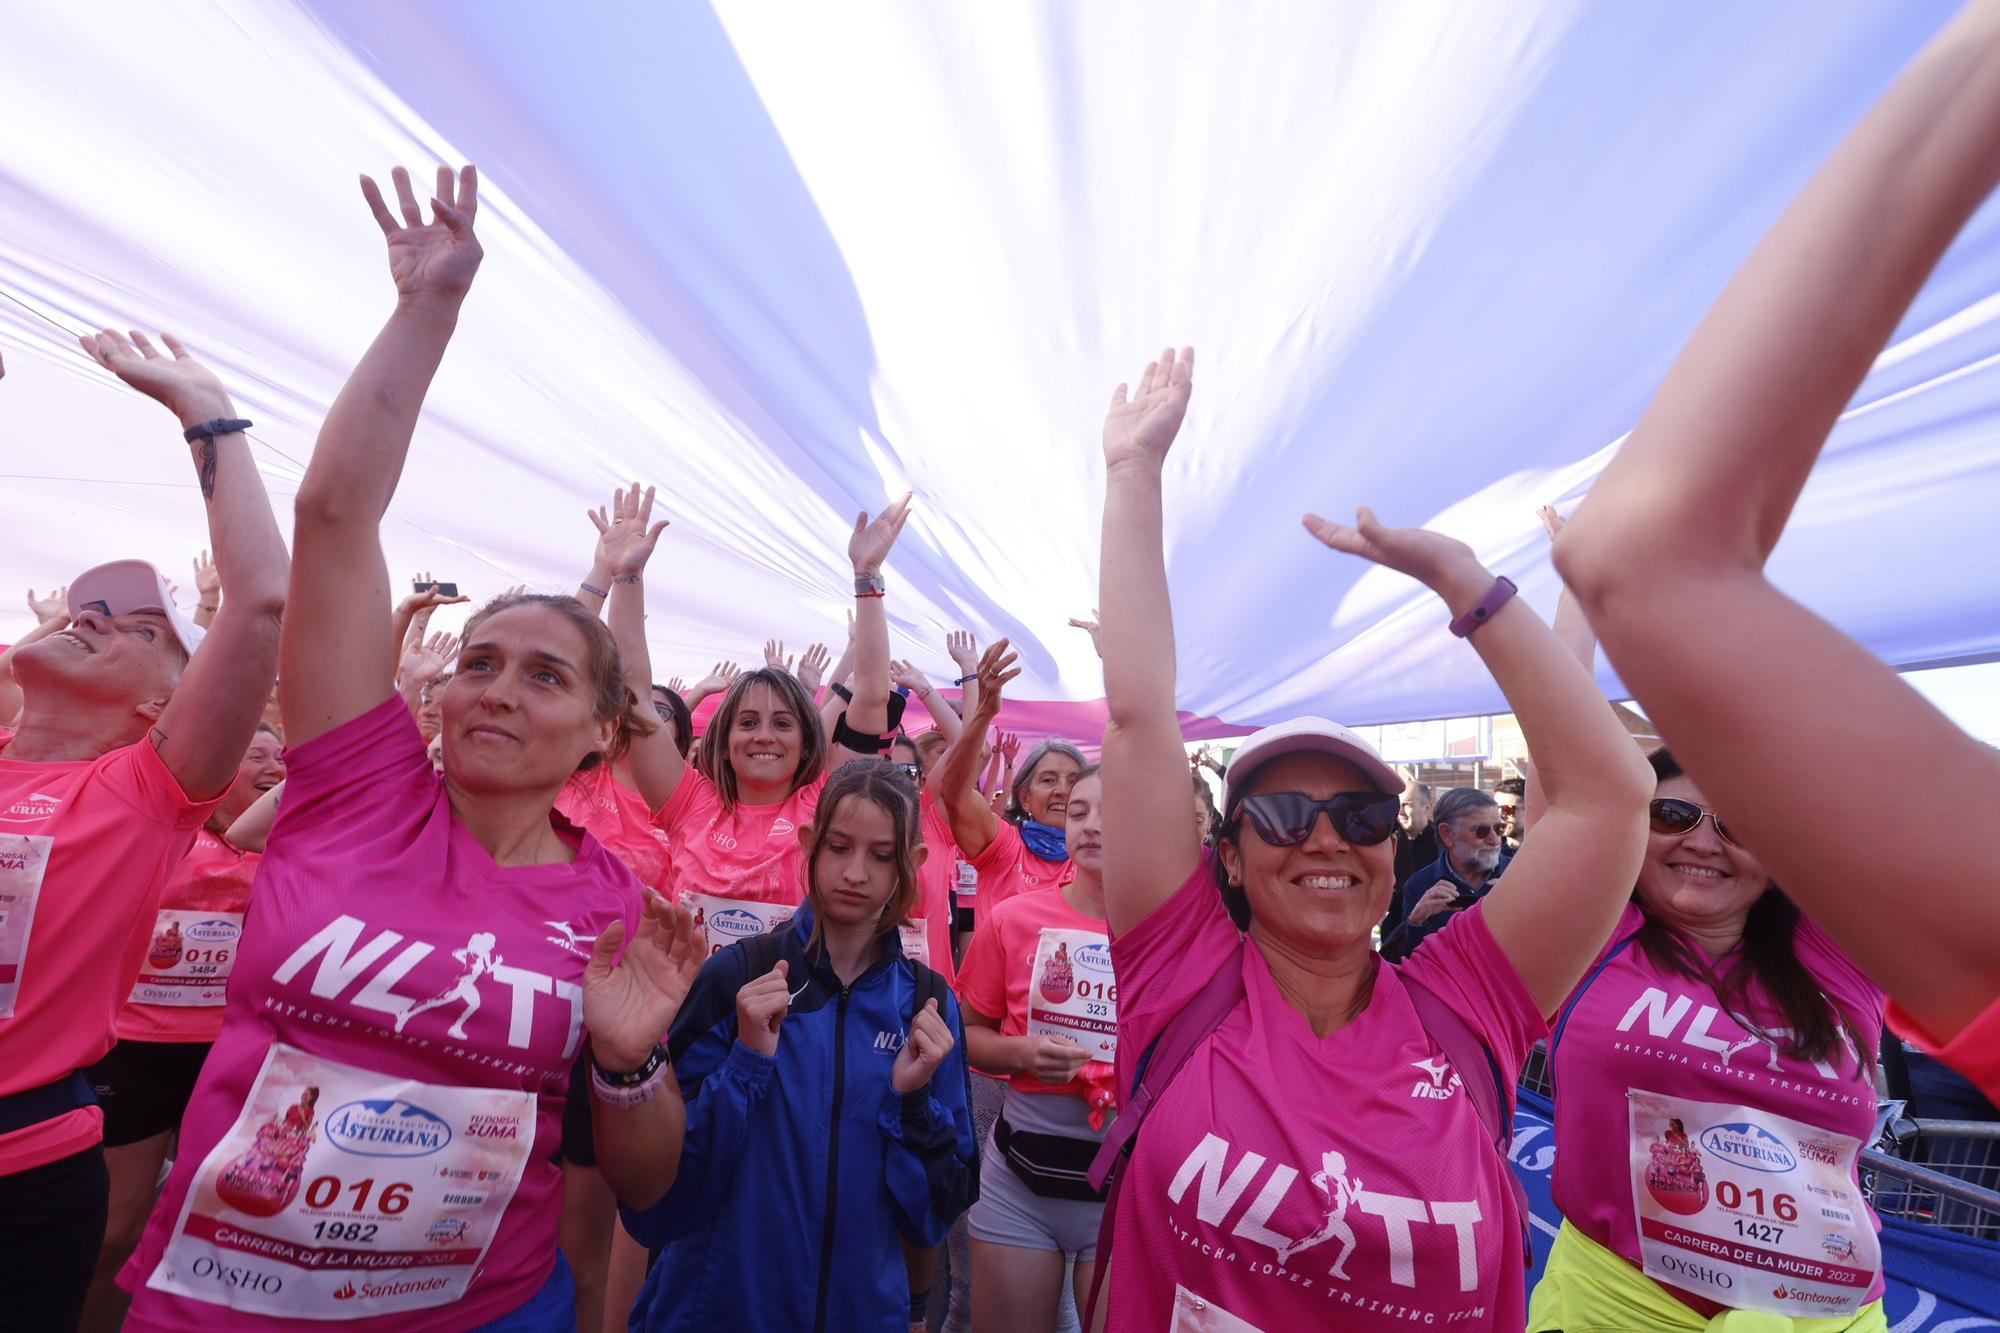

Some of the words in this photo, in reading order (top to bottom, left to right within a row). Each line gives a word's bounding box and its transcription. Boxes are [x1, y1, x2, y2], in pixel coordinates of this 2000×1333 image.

[713, 916, 760, 933] ASTURIANA
[186, 949, 228, 962] 016
[1077, 980, 1117, 1001] 016
[265, 996, 351, 1027] NATACHA
[1044, 1014, 1079, 1028] CARRERA
[1080, 1020, 1092, 1029] DE
[1093, 1022, 1103, 1030] LA
[1086, 1003, 1107, 1016] 323
[1614, 1042, 1688, 1065] NATACHA
[1702, 1062, 1755, 1081] LOPEZ
[1770, 1078, 1859, 1106] TRAINING
[332, 1111, 439, 1147] ASTURIANA
[464, 1124, 518, 1138] SUMA
[1707, 1133, 1792, 1167] ASTURIANA
[1800, 1149, 1836, 1166] SUMA
[305, 1175, 413, 1216] 016
[1716, 1181, 1798, 1222] 016
[314, 1220, 378, 1242] 1982
[1734, 1219, 1784, 1244] 1427
[214, 1228, 294, 1260] CARRERA
[299, 1248, 323, 1265] DE
[327, 1250, 349, 1265] LA
[353, 1253, 413, 1268] MUJER
[1664, 1230, 1729, 1257] CARRERA
[1733, 1250, 1753, 1263] DE
[1757, 1254, 1774, 1267] LA
[1777, 1260, 1823, 1278] MUJER
[1827, 1269, 1856, 1283] 2023
[192, 1256, 282, 1295] OYSHO
[1168, 1215, 1236, 1262] NATACHA
[1250, 1261, 1313, 1288] LOPEZ
[1328, 1287, 1435, 1324] TRAINING
[1446, 1306, 1485, 1323] TEAM
[1661, 1254, 1733, 1290] OYSHO
[359, 1276, 450, 1299] Santander
[1790, 1287, 1851, 1306] Santander
